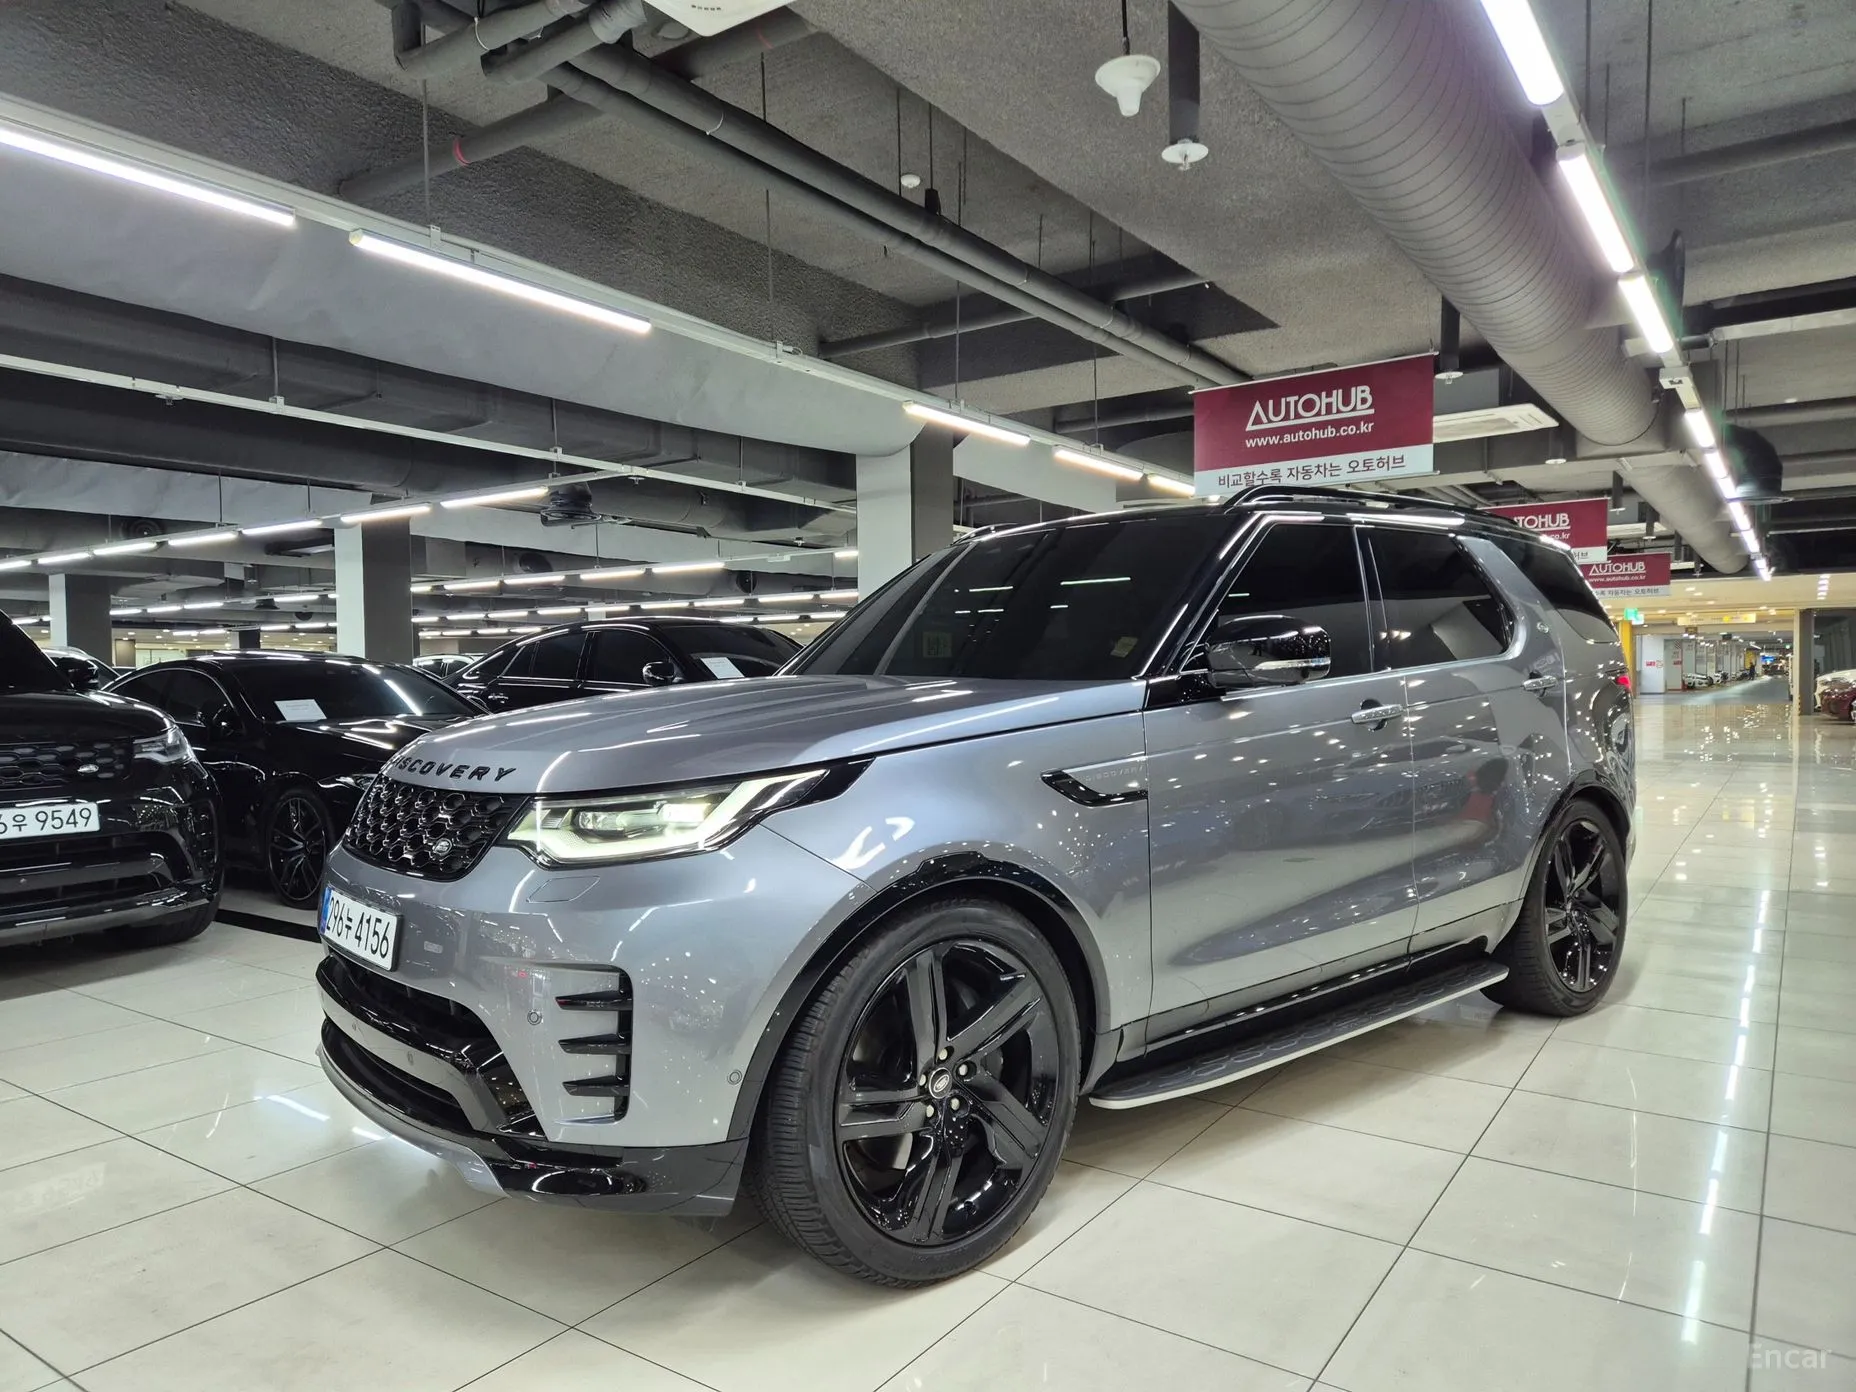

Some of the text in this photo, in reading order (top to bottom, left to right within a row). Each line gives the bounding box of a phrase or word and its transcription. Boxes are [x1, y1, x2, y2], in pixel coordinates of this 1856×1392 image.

[1246, 385, 1375, 431] AUTOHUB
[1246, 421, 1374, 448] www.autohub.co.kr
[1218, 454, 1406, 488] 비교할수록 자동차는 오토허브
[1513, 513, 1571, 531] TOHUB
[1589, 561, 1646, 576] AUTOHUB
[35, 807, 92, 831] 9549
[326, 897, 391, 959] 296누 4156
